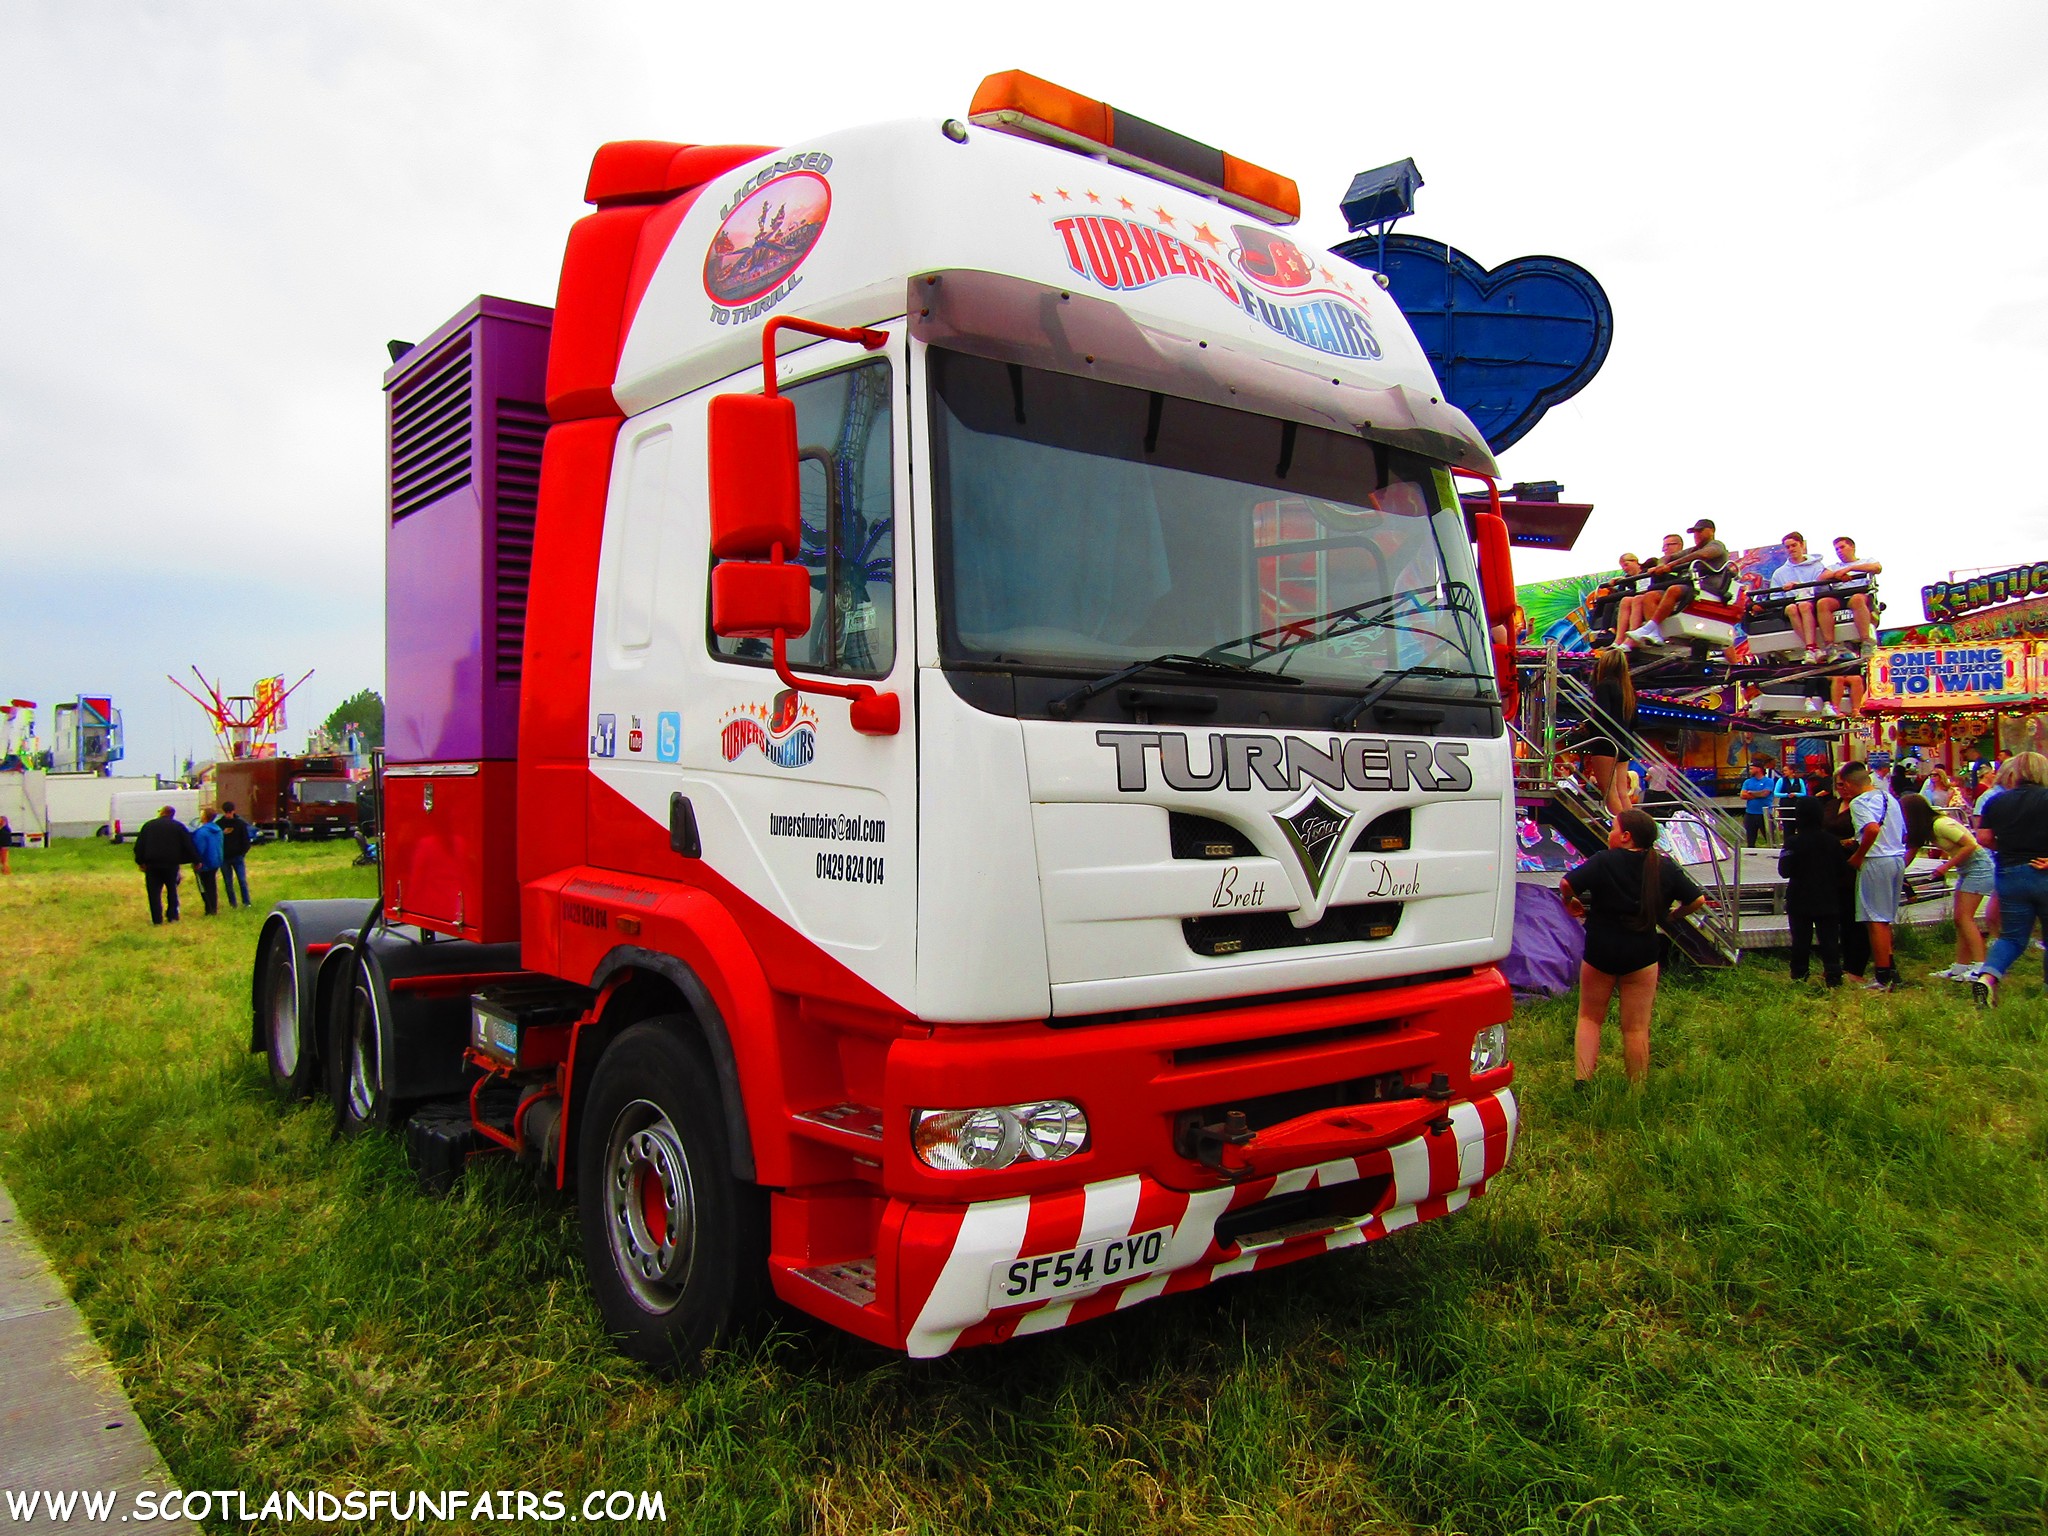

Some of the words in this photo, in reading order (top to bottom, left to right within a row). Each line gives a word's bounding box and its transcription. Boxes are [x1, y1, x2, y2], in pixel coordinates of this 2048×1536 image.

[720, 152, 833, 220] LICENSED
[1052, 216, 1241, 307] TURNERS
[710, 304, 730, 326] TO
[732, 274, 803, 325] THRILL
[1235, 281, 1383, 359] FUNFAIRS
[1890, 651, 1937, 667] ONE
[1944, 648, 2003, 665] RING
[1890, 667, 1926, 676] OVER
[1930, 665, 1955, 674] THE
[1960, 663, 2003, 673] BLOCK
[1891, 676, 1930, 694] TO
[1940, 672, 2003, 692] WIN
[630, 733, 642, 748] Tube
[631, 714, 641, 729] You
[721, 718, 766, 762] TURNERS
[765, 729, 815, 768] FUNFAIRS
[1096, 731, 1472, 792] TURNERS
[770, 812, 886, 843] turnersfunfairs@aol.com
[816, 852, 844, 881] 01429
[845, 855, 864, 883] 824
[866, 856, 884, 885] 014
[1213, 866, 1265, 908] Brett
[1367, 859, 1420, 898] Derek
[1006, 1248, 1094, 1297] SF54
[1103, 1231, 1162, 1276] GYO
